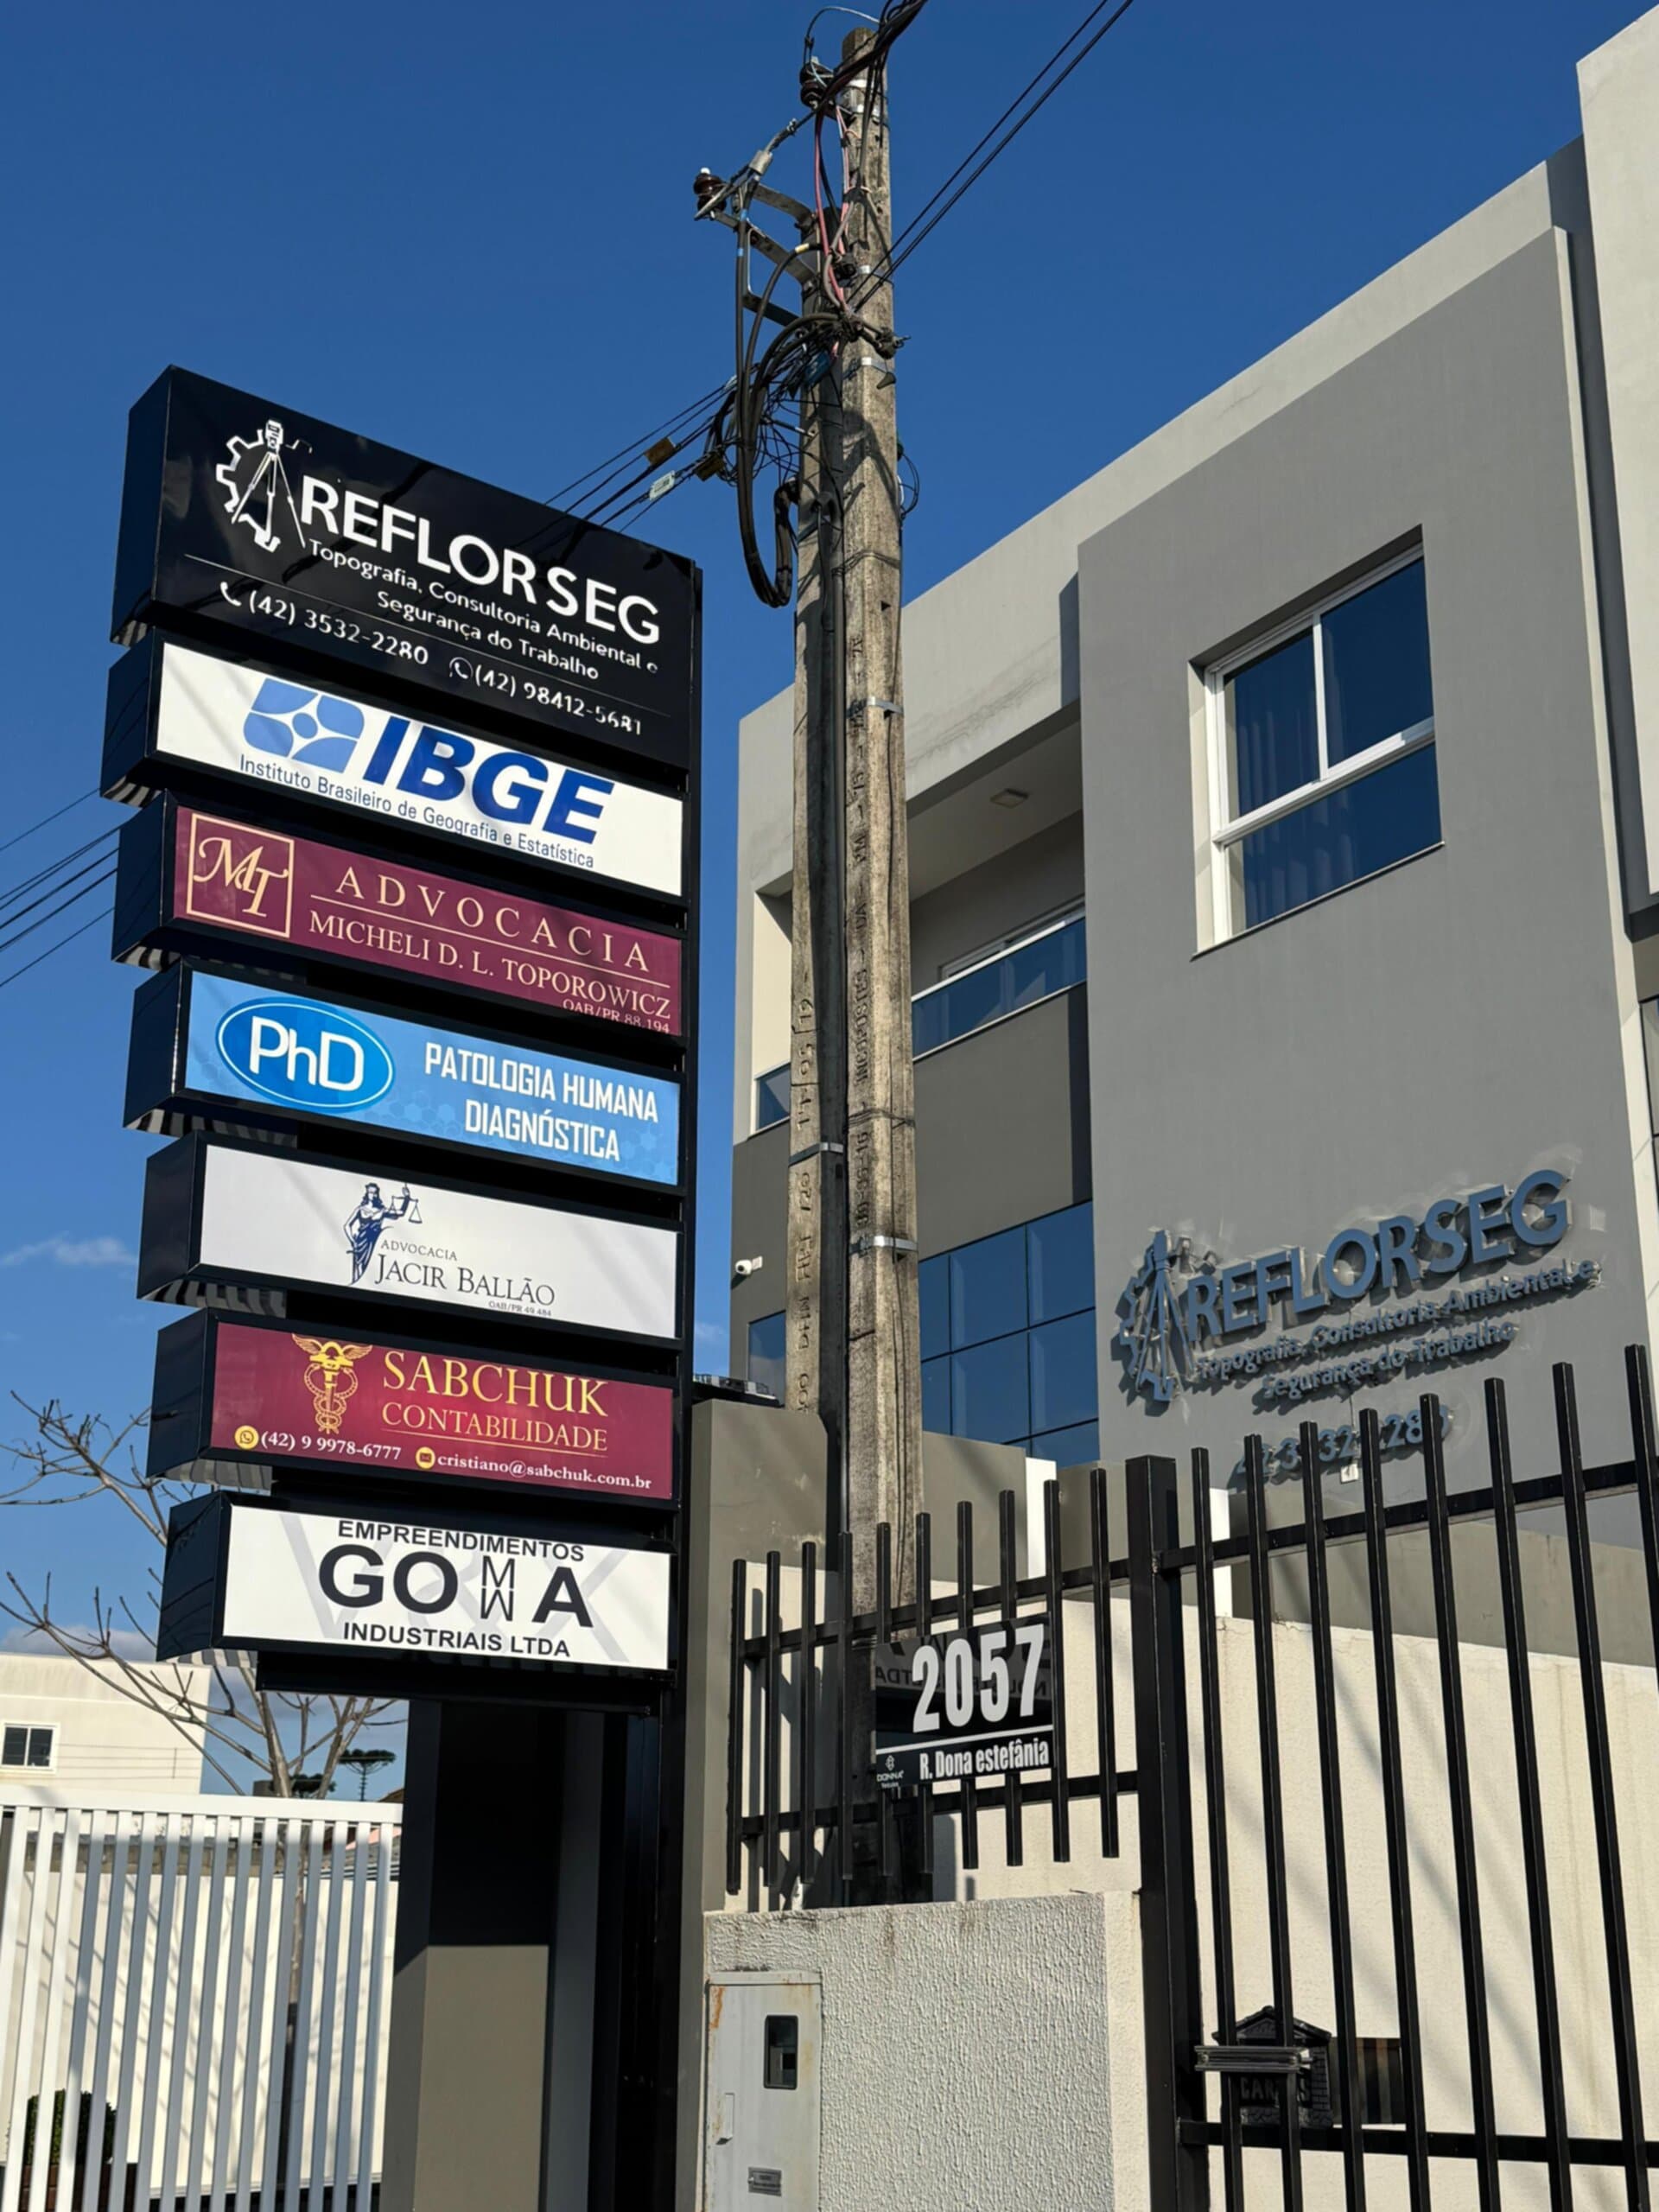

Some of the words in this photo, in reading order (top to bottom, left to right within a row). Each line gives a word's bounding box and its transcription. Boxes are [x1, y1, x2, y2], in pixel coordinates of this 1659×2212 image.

[300, 475, 659, 644] REFLORSEG
[250, 590, 296, 626] (42)
[304, 609, 429, 664] 3532-2280
[475, 664, 516, 697] (42)
[378, 590, 481, 641] Segurança
[486, 630, 512, 650] do
[519, 639, 599, 679] Trabalho
[429, 582, 540, 632] Consultoria
[547, 624, 641, 669] Ambiental
[240, 753, 310, 789] Instituto
[318, 776, 391, 812] Brasileiro
[397, 800, 417, 820] de
[423, 807, 498, 842] Geografia
[503, 831, 512, 846] e
[518, 833, 594, 868] Estatística
[363, 715, 614, 844] IBGE
[335, 867, 650, 972] ADVOCACIA
[309, 911, 430, 961] MICHELI
[438, 942, 464, 969] D.
[472, 950, 494, 976] L.
[501, 958, 671, 1019] TOPOROWICZ
[563, 999, 620, 1021] OAB/PR
[249, 1015, 364, 1092] PhD
[424, 1042, 556, 1102] PATOLOGIA
[563, 1073, 658, 1123] HUMANA
[465, 1099, 620, 1162] DIAGNÓSTICA
[380, 1240, 457, 1262] ADVOCACIA
[1187, 1169, 1572, 1342] REFLORSEG
[1311, 1300, 1439, 1349] Consultoria
[1444, 1259, 1572, 1314] Ambiental
[384, 1351, 608, 1417] SABCHUK
[1262, 1358, 1372, 1400] Segurança
[1377, 1344, 1407, 1370] do
[1414, 1320, 1515, 1363] Trabalho
[261, 1431, 296, 1452] (42)
[301, 1435, 312, 1449] 9
[316, 1437, 402, 1460] 9978-6777
[382, 1402, 607, 1452] CONTABILIDADE
[437, 1453, 652, 1490] cristiano@sabchuk.com.br
[337, 1520, 585, 1561] EMPREENDIMENTOS
[344, 1622, 502, 1651] INDUSTRIAIS
[510, 1636, 571, 1657] LTDA
[912, 1624, 1045, 1733] 2057
[919, 1752, 933, 1780] R.
[935, 1749, 973, 1778] Dona
[976, 1738, 1049, 1772] estefânia
